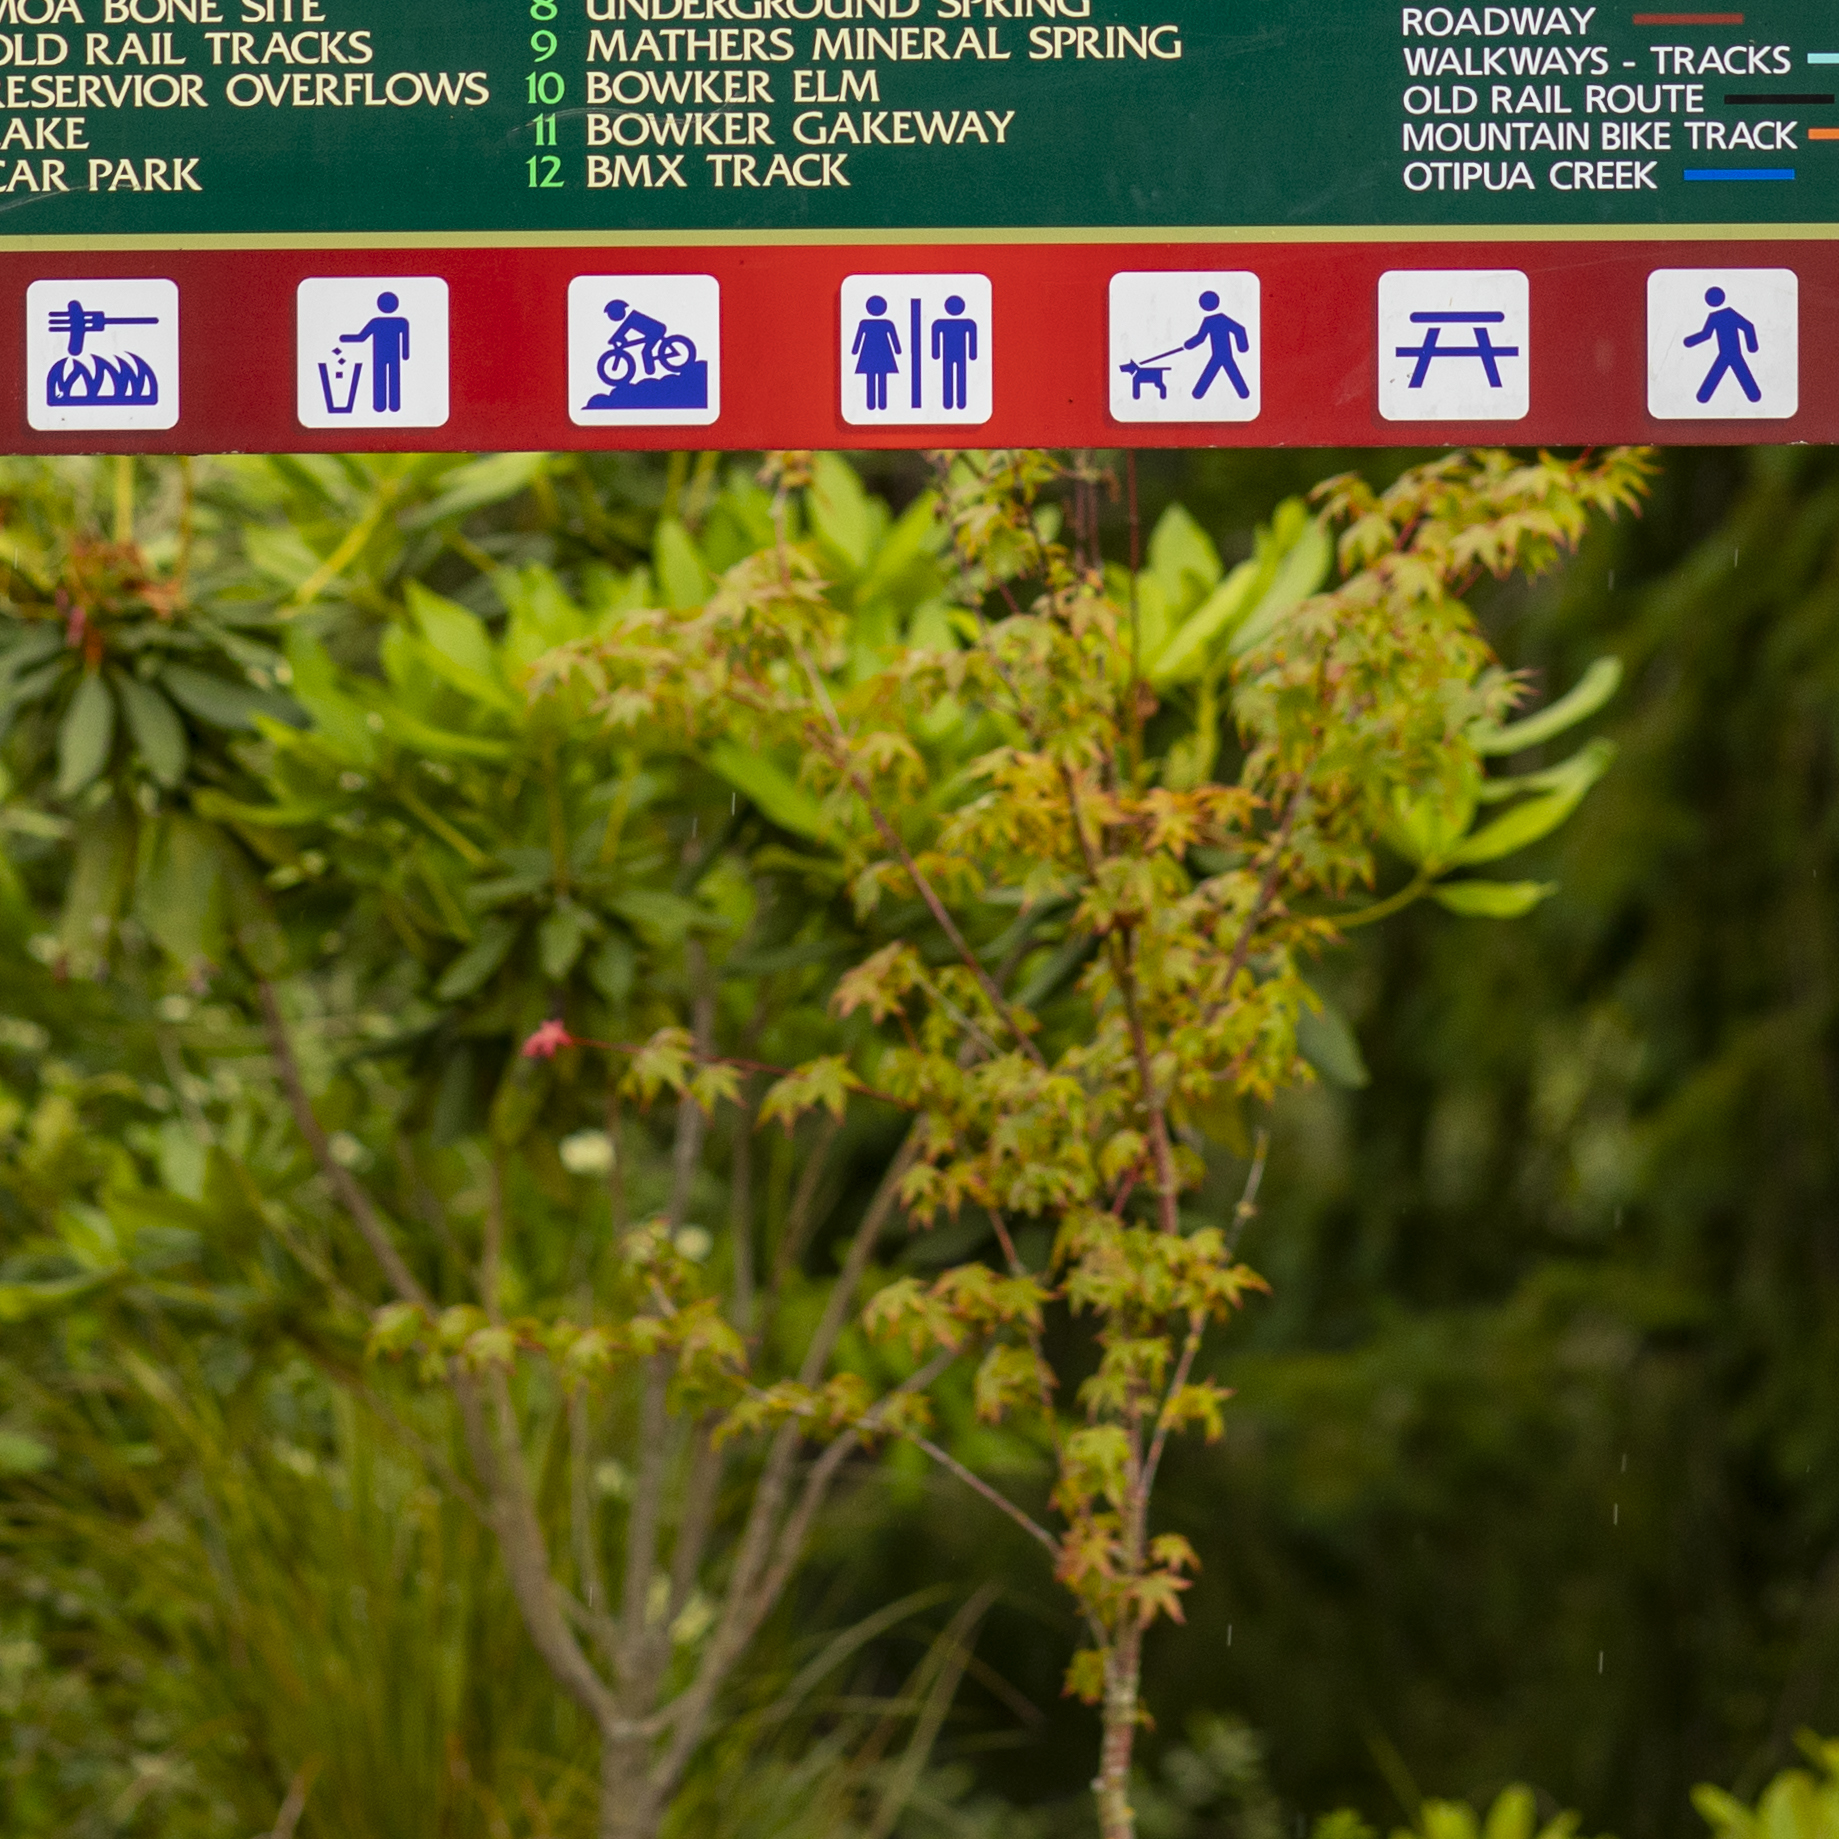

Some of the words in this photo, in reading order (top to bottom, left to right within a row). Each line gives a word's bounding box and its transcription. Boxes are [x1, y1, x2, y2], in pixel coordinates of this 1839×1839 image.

[1402, 6, 1596, 37] ROADWAY
[86, 31, 186, 66] RAIL
[204, 30, 373, 65] TRACKS
[530, 29, 558, 64] 9
[585, 27, 795, 63] MATHERS
[811, 26, 1011, 61] MINERAL
[1028, 24, 1183, 60] SPRING
[1403, 46, 1609, 76] WALKWAYS
[1650, 45, 1791, 76] TRACKS
[225, 71, 490, 108] OVERFLOWS
[525, 70, 565, 105] 10
[585, 69, 776, 105] BOWKER
[793, 69, 880, 103] ELM
[1402, 85, 1478, 115] OLD
[1491, 85, 1572, 114] RAIL
[1585, 83, 1705, 114] ROUTE
[533, 114, 557, 146] 11
[585, 111, 776, 146] BOWKER
[791, 110, 1016, 145] GAKEWAY
[1402, 122, 1590, 152] MOUNTAIN
[1601, 121, 1671, 151] BIKE
[1684, 120, 1799, 150] TRACK
[88, 157, 203, 191] PARK
[526, 155, 565, 188] 12
[585, 155, 687, 188] BMX
[706, 154, 852, 187] TRACK
[1402, 162, 1536, 191] OTIPUA
[1549, 160, 1659, 190] CREEK
